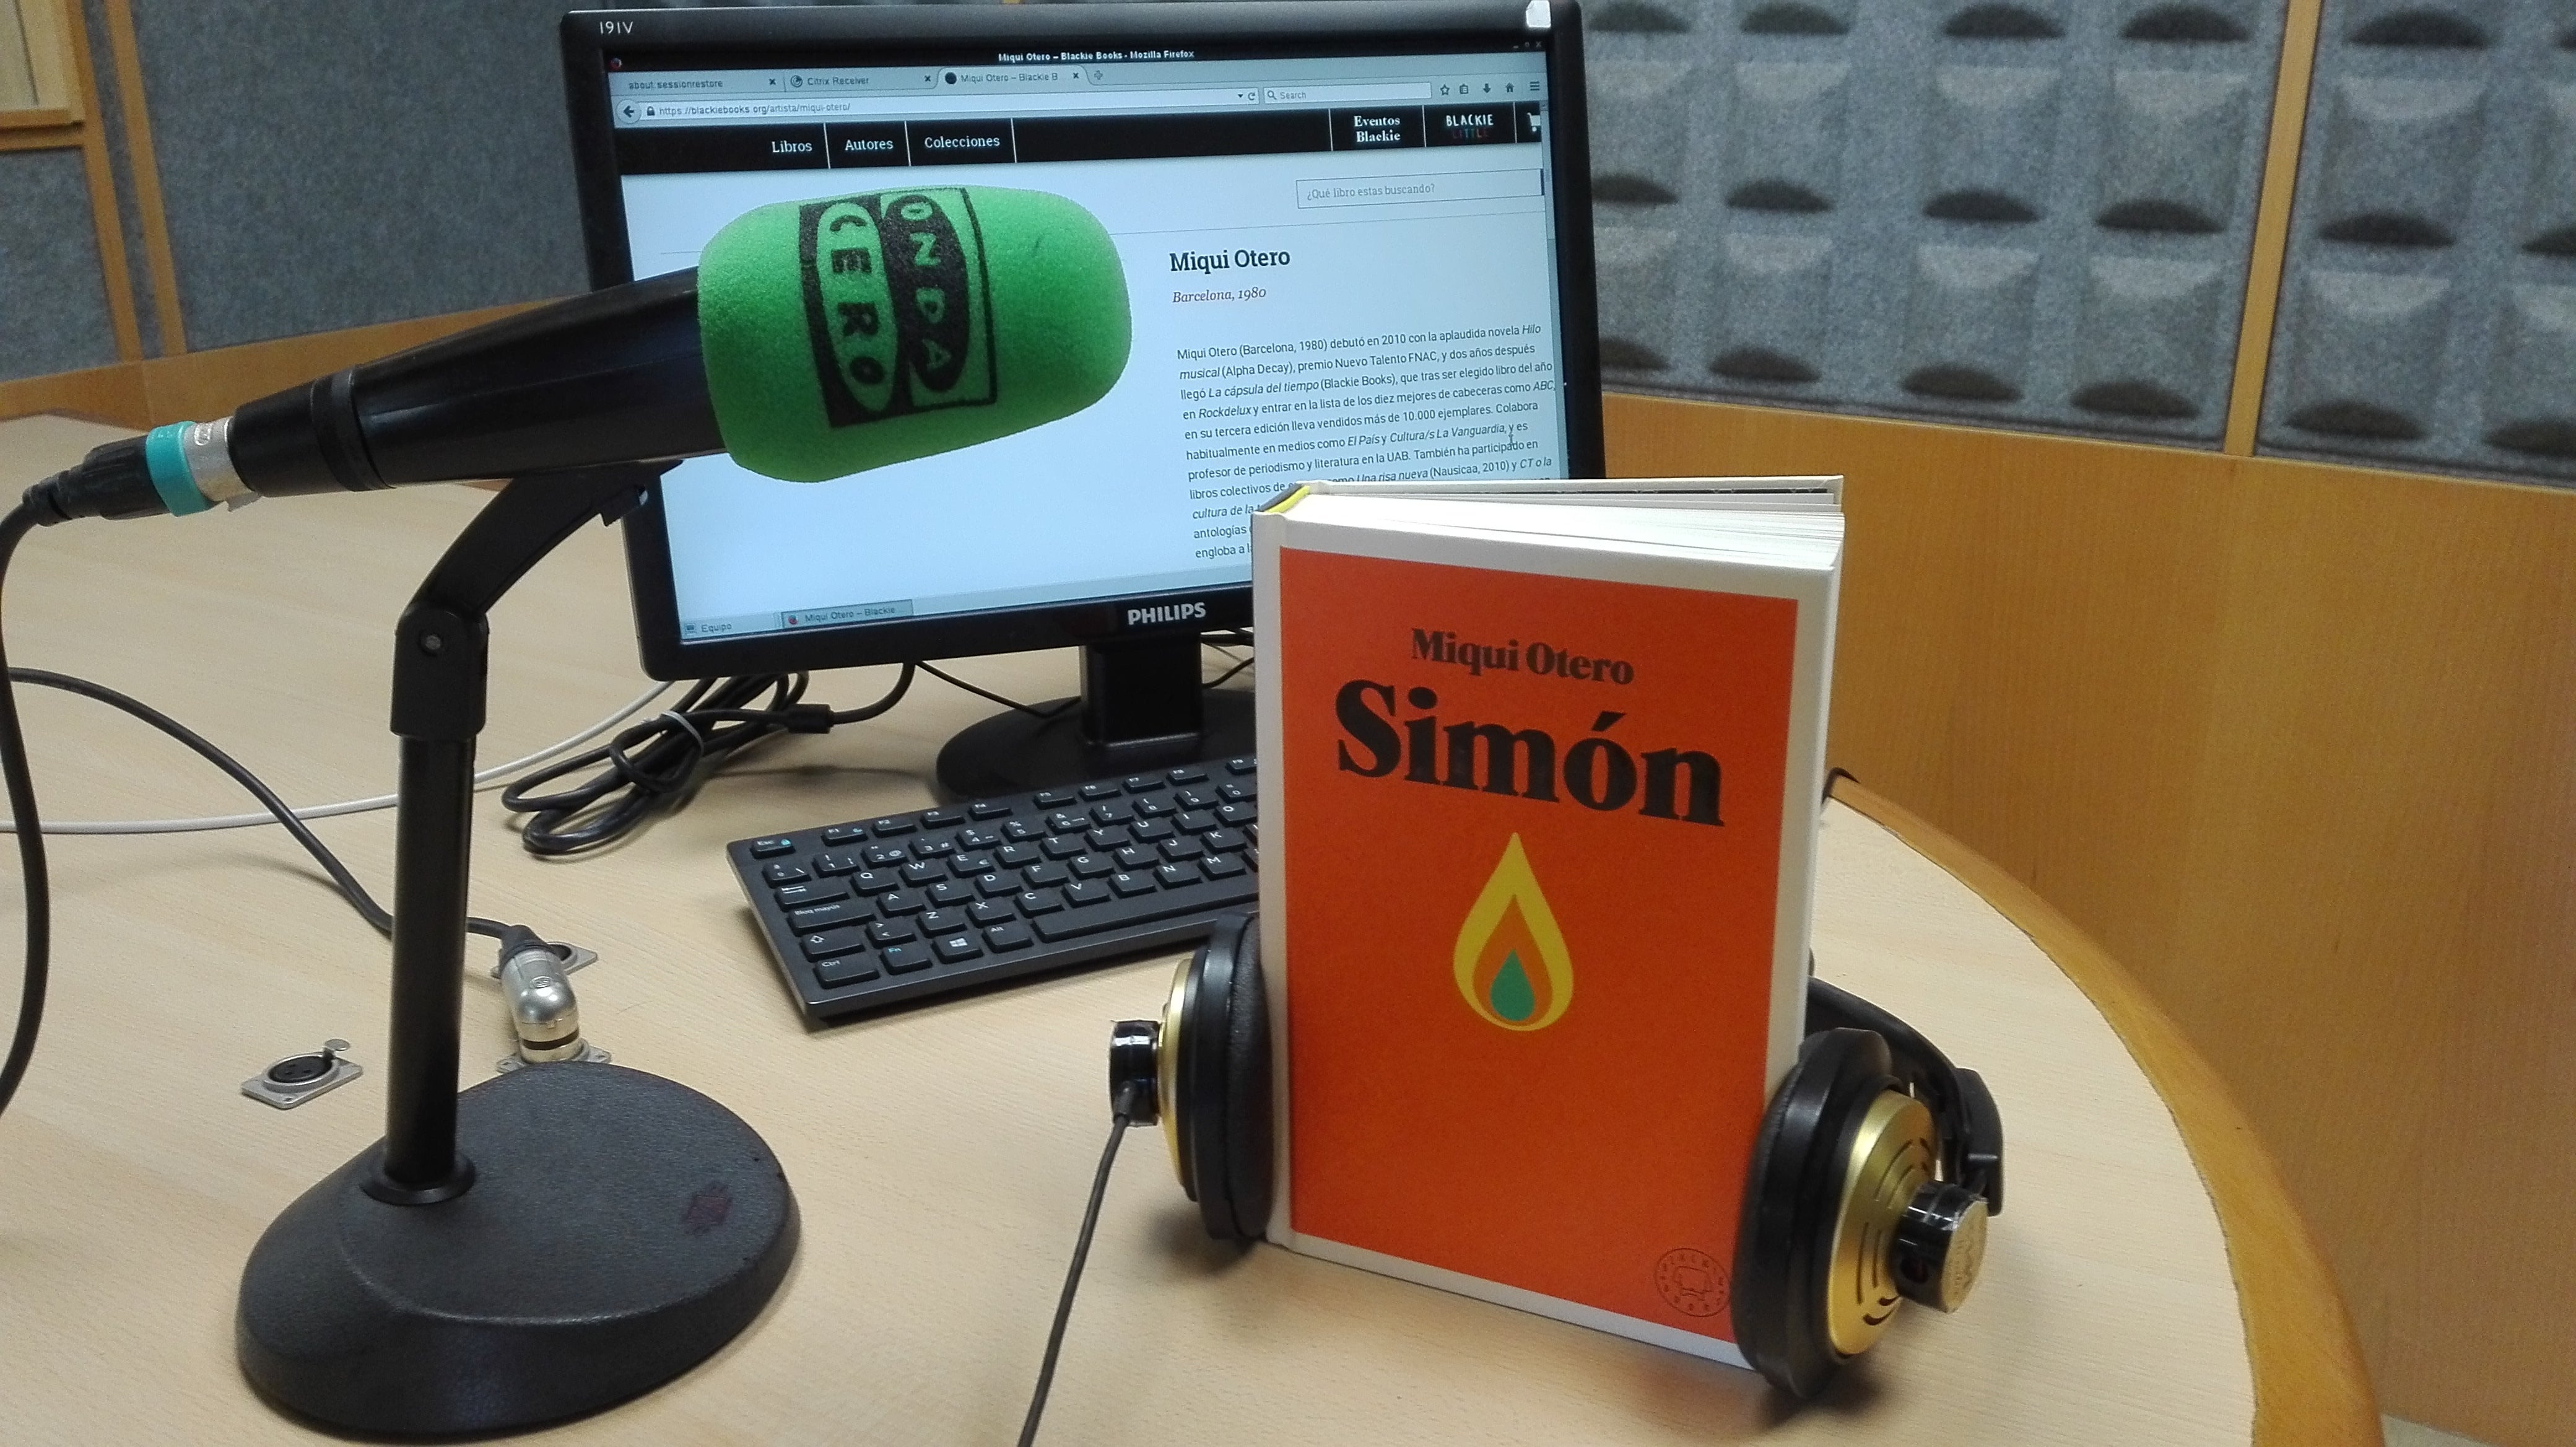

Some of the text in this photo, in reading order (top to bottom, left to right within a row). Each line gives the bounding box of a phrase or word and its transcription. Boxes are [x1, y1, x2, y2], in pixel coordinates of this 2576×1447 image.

[998, 49, 1194, 63] Miqui Otero Blackie Books Mozilla Firefox
[1280, 91, 1307, 100] Search
[1354, 115, 1401, 128] Eventos
[1446, 114, 1494, 126] BLACKIE
[925, 135, 1001, 149] Colecciones
[1356, 130, 1401, 143] Blackie
[772, 140, 812, 153] Libros
[845, 139, 894, 151] Autores
[1307, 183, 1435, 201] ¿Qué libro estas buscando?
[1168, 248, 1290, 275] Miqui Otero
[901, 198, 952, 370] ONDA
[829, 214, 884, 385] CERO
[1172, 286, 1267, 304] Barcelona, 1980
[1177, 323, 1541, 362] Miqui Otero (Barcelona, 1980) debutó en 2010 con la aplaudida novela Hilo
[1179, 343, 1536, 380] musical (Alpha Decay), premio Nuevo Talento FNAC, y dos años después
[1180, 361, 1552, 402] llegó La cápsula del tiempo (Blackie Books), que tras ser elegido libro del año
[1183, 380, 1556, 421] en Rockdelux y entrar en la lista de los diez mejores de cabeceras como ABC,
[1184, 402, 1538, 440] en su tercera edición lleva vendidos más de 10.000 ejemplares. Colabora
[1186, 422, 1528, 460] habitualmente en medios como El País y Cultura/s La Vanguardia, y es
[1188, 440, 1538, 483] profesor de periodismo y literatura en la UAB. También ha participado en
[1190, 489, 1219, 500] libros
[1220, 484, 1271, 497] colectivos
[1273, 481, 1286, 492] de
[1378, 472, 1396, 482] risa
[1398, 470, 1429, 481] nueva
[1430, 465, 1481, 479] (Nausicaa,
[1482, 460, 1510, 473] 2010)
[1511, 461, 1517, 473] y
[1520, 458, 1534, 469] CT
[1535, 459, 1542, 468] o
[1543, 457, 1552, 466] la
[1192, 504, 1253, 520] cultura de la
[1194, 525, 1247, 540] antologías
[1195, 545, 1237, 560] engloba
[805, 613, 829, 624] Miqui
[831, 610, 854, 620] Otero
[1128, 602, 1206, 625] PHILIPS
[701, 623, 732, 634] Equipo
[1411, 627, 1634, 685] Miqui Otero
[1335, 679, 1725, 827] Simón
[908, 861, 926, 870] W
[1206, 856, 1222, 865] M
[983, 874, 997, 882] D
[925, 911, 941, 920] Z
[821, 960, 842, 968] Ctrl
